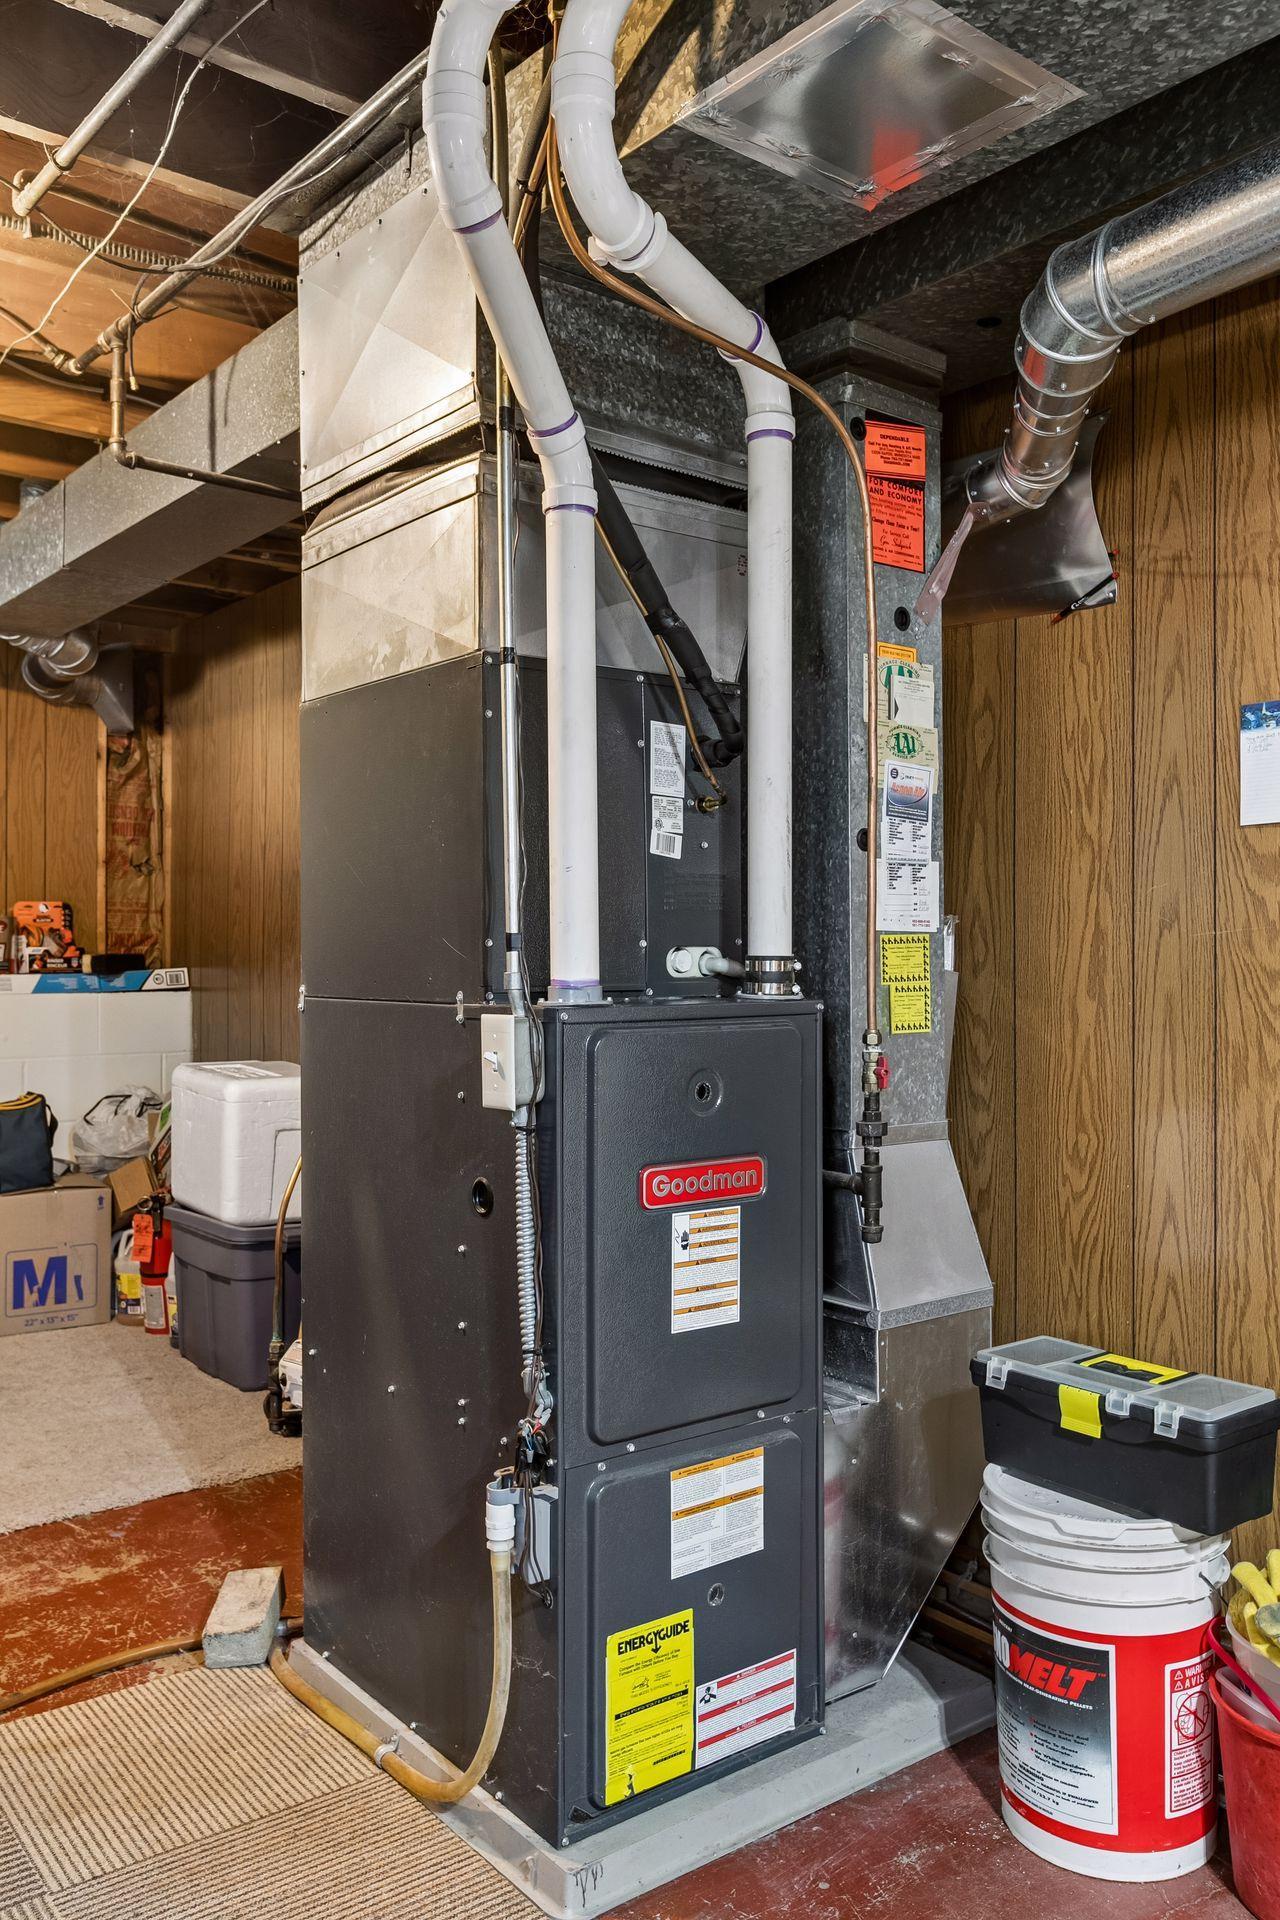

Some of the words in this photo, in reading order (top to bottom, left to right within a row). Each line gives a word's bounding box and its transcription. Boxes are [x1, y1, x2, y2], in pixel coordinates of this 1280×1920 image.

[869, 475, 884, 487] FOR
[888, 481, 922, 496] COMFORT
[870, 486, 884, 496] AND
[888, 490, 922, 505] ECONOMY
[652, 1169, 758, 1197] Goodman
[13, 1256, 67, 1310] M
[25, 1319, 38, 1327] 22"
[618, 1620, 690, 1655] ENERGYGUIDE
[1023, 1682, 1068, 1704] HEAT-GENERATING
[1069, 1700, 1093, 1710] PELLETS
[1033, 1724, 1056, 1738] Freezing
[1043, 1753, 1060, 1763] White
[1046, 1745, 1073, 1758] Concrete.
[1018, 1763, 1044, 1782] WARNING
[1035, 1754, 1050, 1764] Won't
[1052, 1762, 1068, 1771] Harm
[1069, 1769, 1095, 1778] Carpets.
[1068, 1793, 1099, 1805] SWALLOWED
